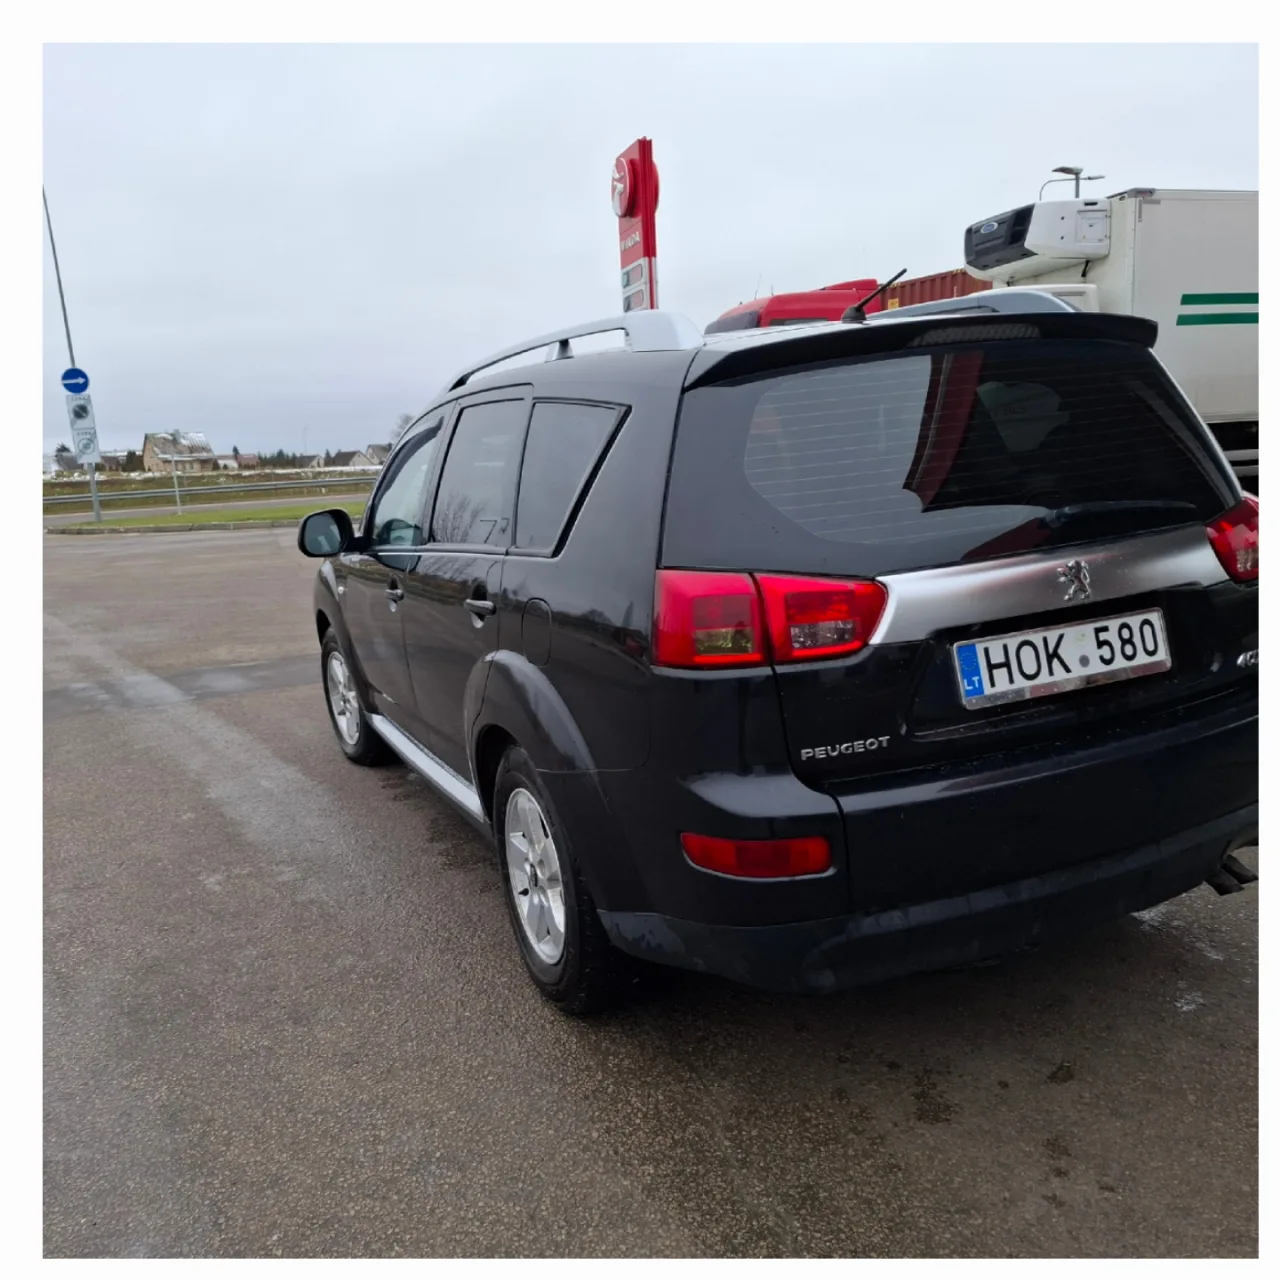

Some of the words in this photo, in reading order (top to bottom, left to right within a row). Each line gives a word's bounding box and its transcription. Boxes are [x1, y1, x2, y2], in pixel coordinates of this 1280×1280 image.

[983, 632, 1072, 688] HOK
[1093, 617, 1159, 666] 580
[963, 676, 980, 691] LT
[801, 735, 890, 760] PEUGEOT
